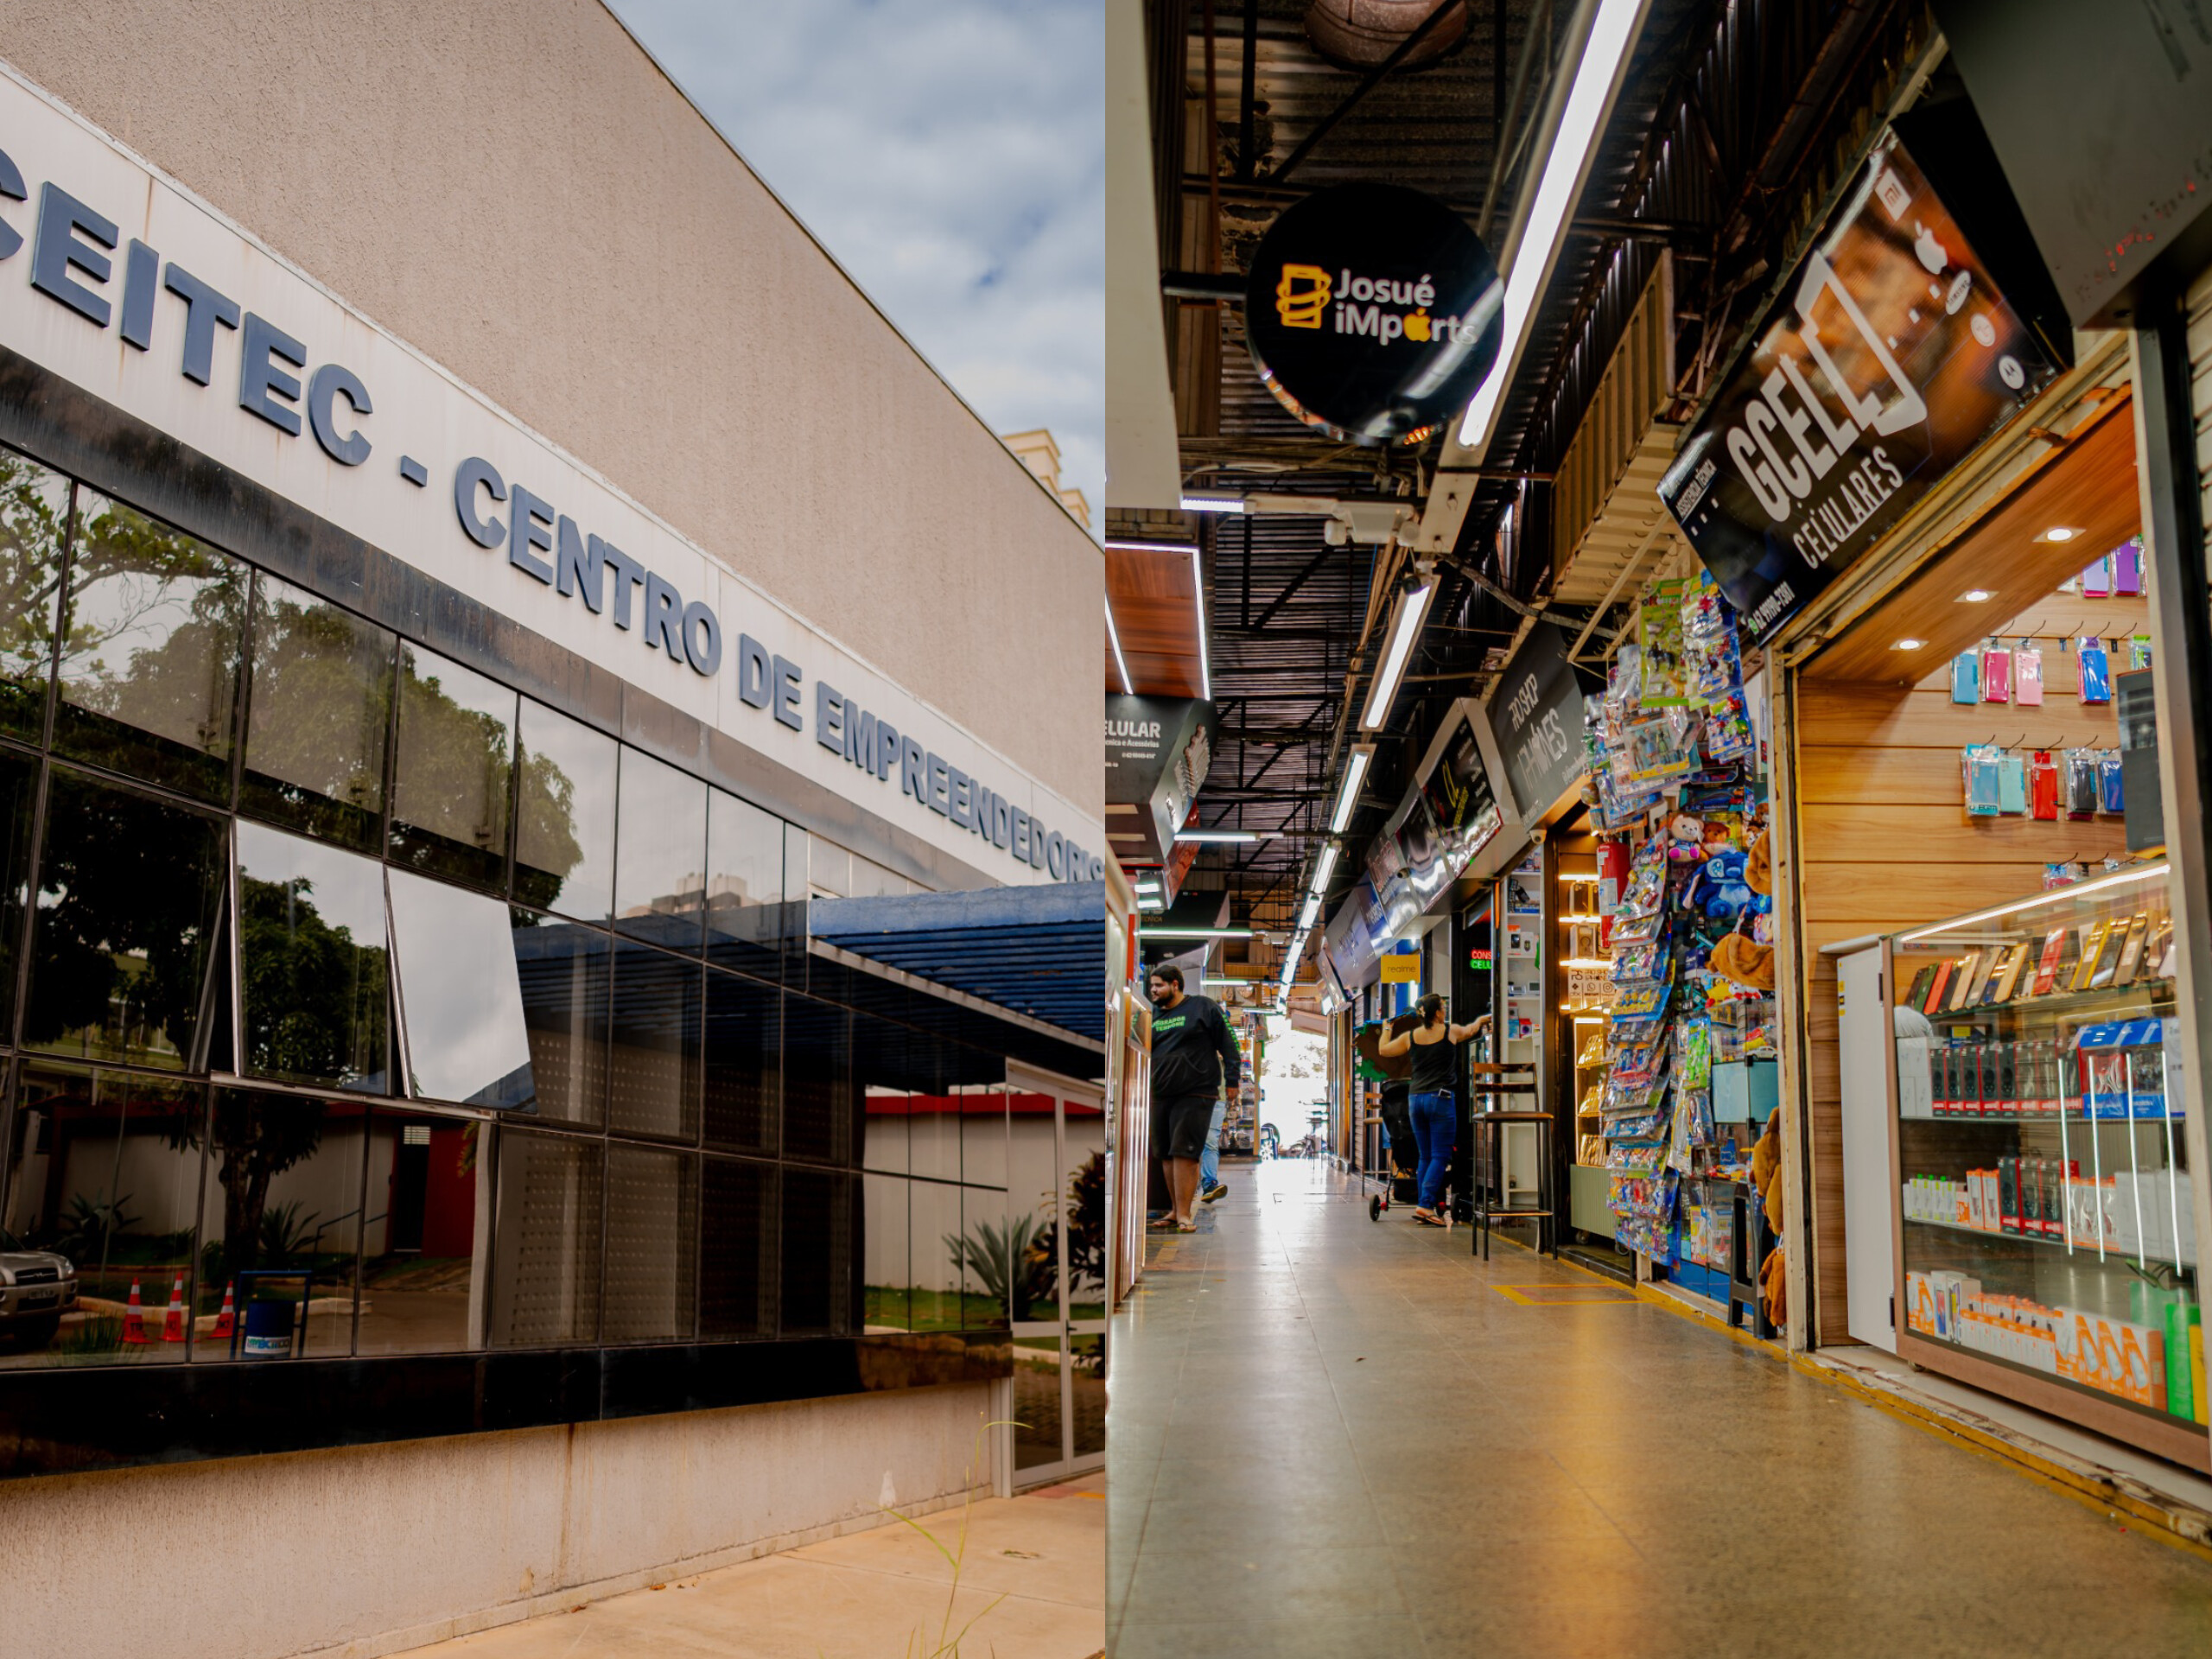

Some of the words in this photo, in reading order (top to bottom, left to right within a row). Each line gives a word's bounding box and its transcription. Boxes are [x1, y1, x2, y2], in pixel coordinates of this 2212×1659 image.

[1334, 269, 1435, 308] Josué
[1793, 445, 1903, 569] CELULARES
[454, 456, 722, 677] CENTRO
[739, 633, 803, 732] DE
[1387, 964, 1416, 974] realme
